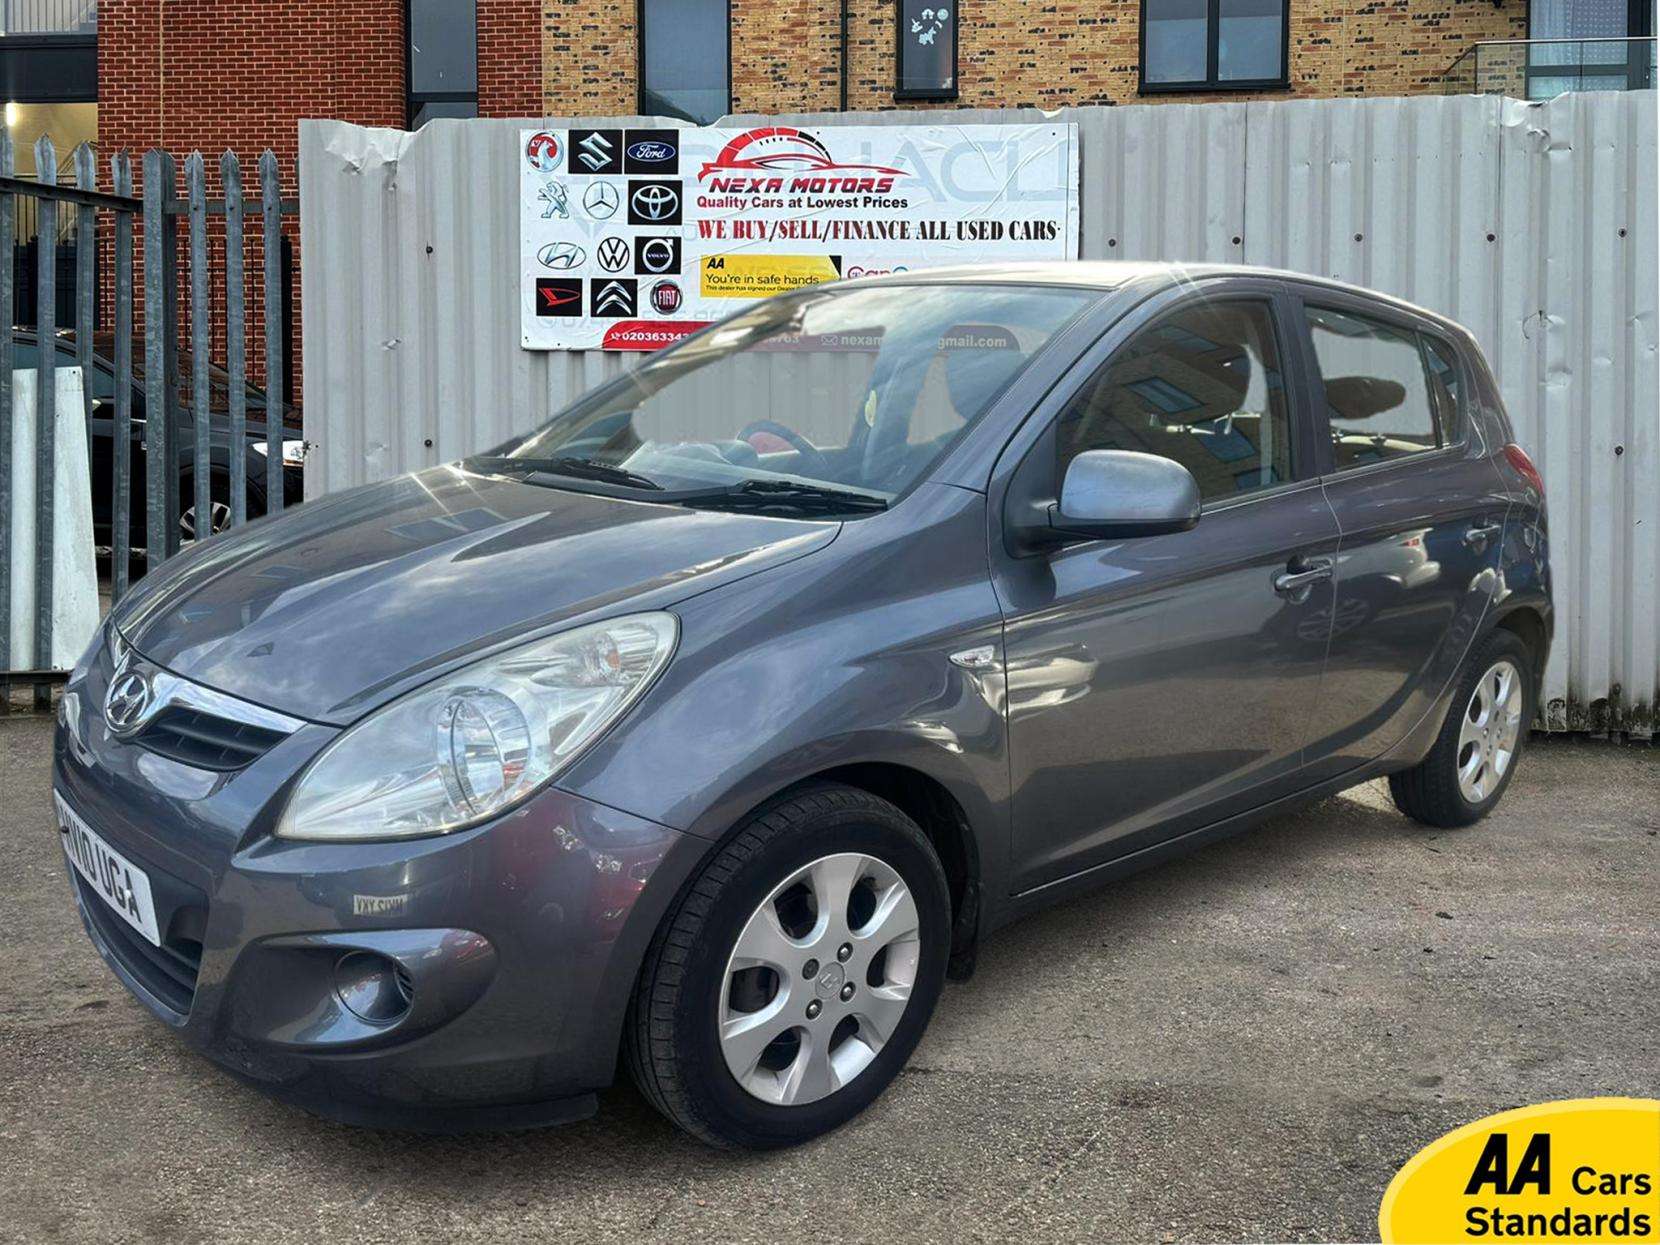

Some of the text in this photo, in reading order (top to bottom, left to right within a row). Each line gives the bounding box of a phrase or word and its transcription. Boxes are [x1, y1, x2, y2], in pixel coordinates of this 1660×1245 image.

[636, 143, 666, 158] Ford
[709, 178, 894, 194] NEXA MOTORS
[697, 196, 908, 210] Quality Cars at Lowest Prices
[697, 220, 727, 240] WE
[916, 220, 951, 240] ALL
[956, 220, 1004, 240] USED
[1008, 220, 1057, 240] CARS
[706, 257, 725, 269] AA
[706, 274, 820, 285] You're in safe hands
[658, 290, 676, 306] FIAT
